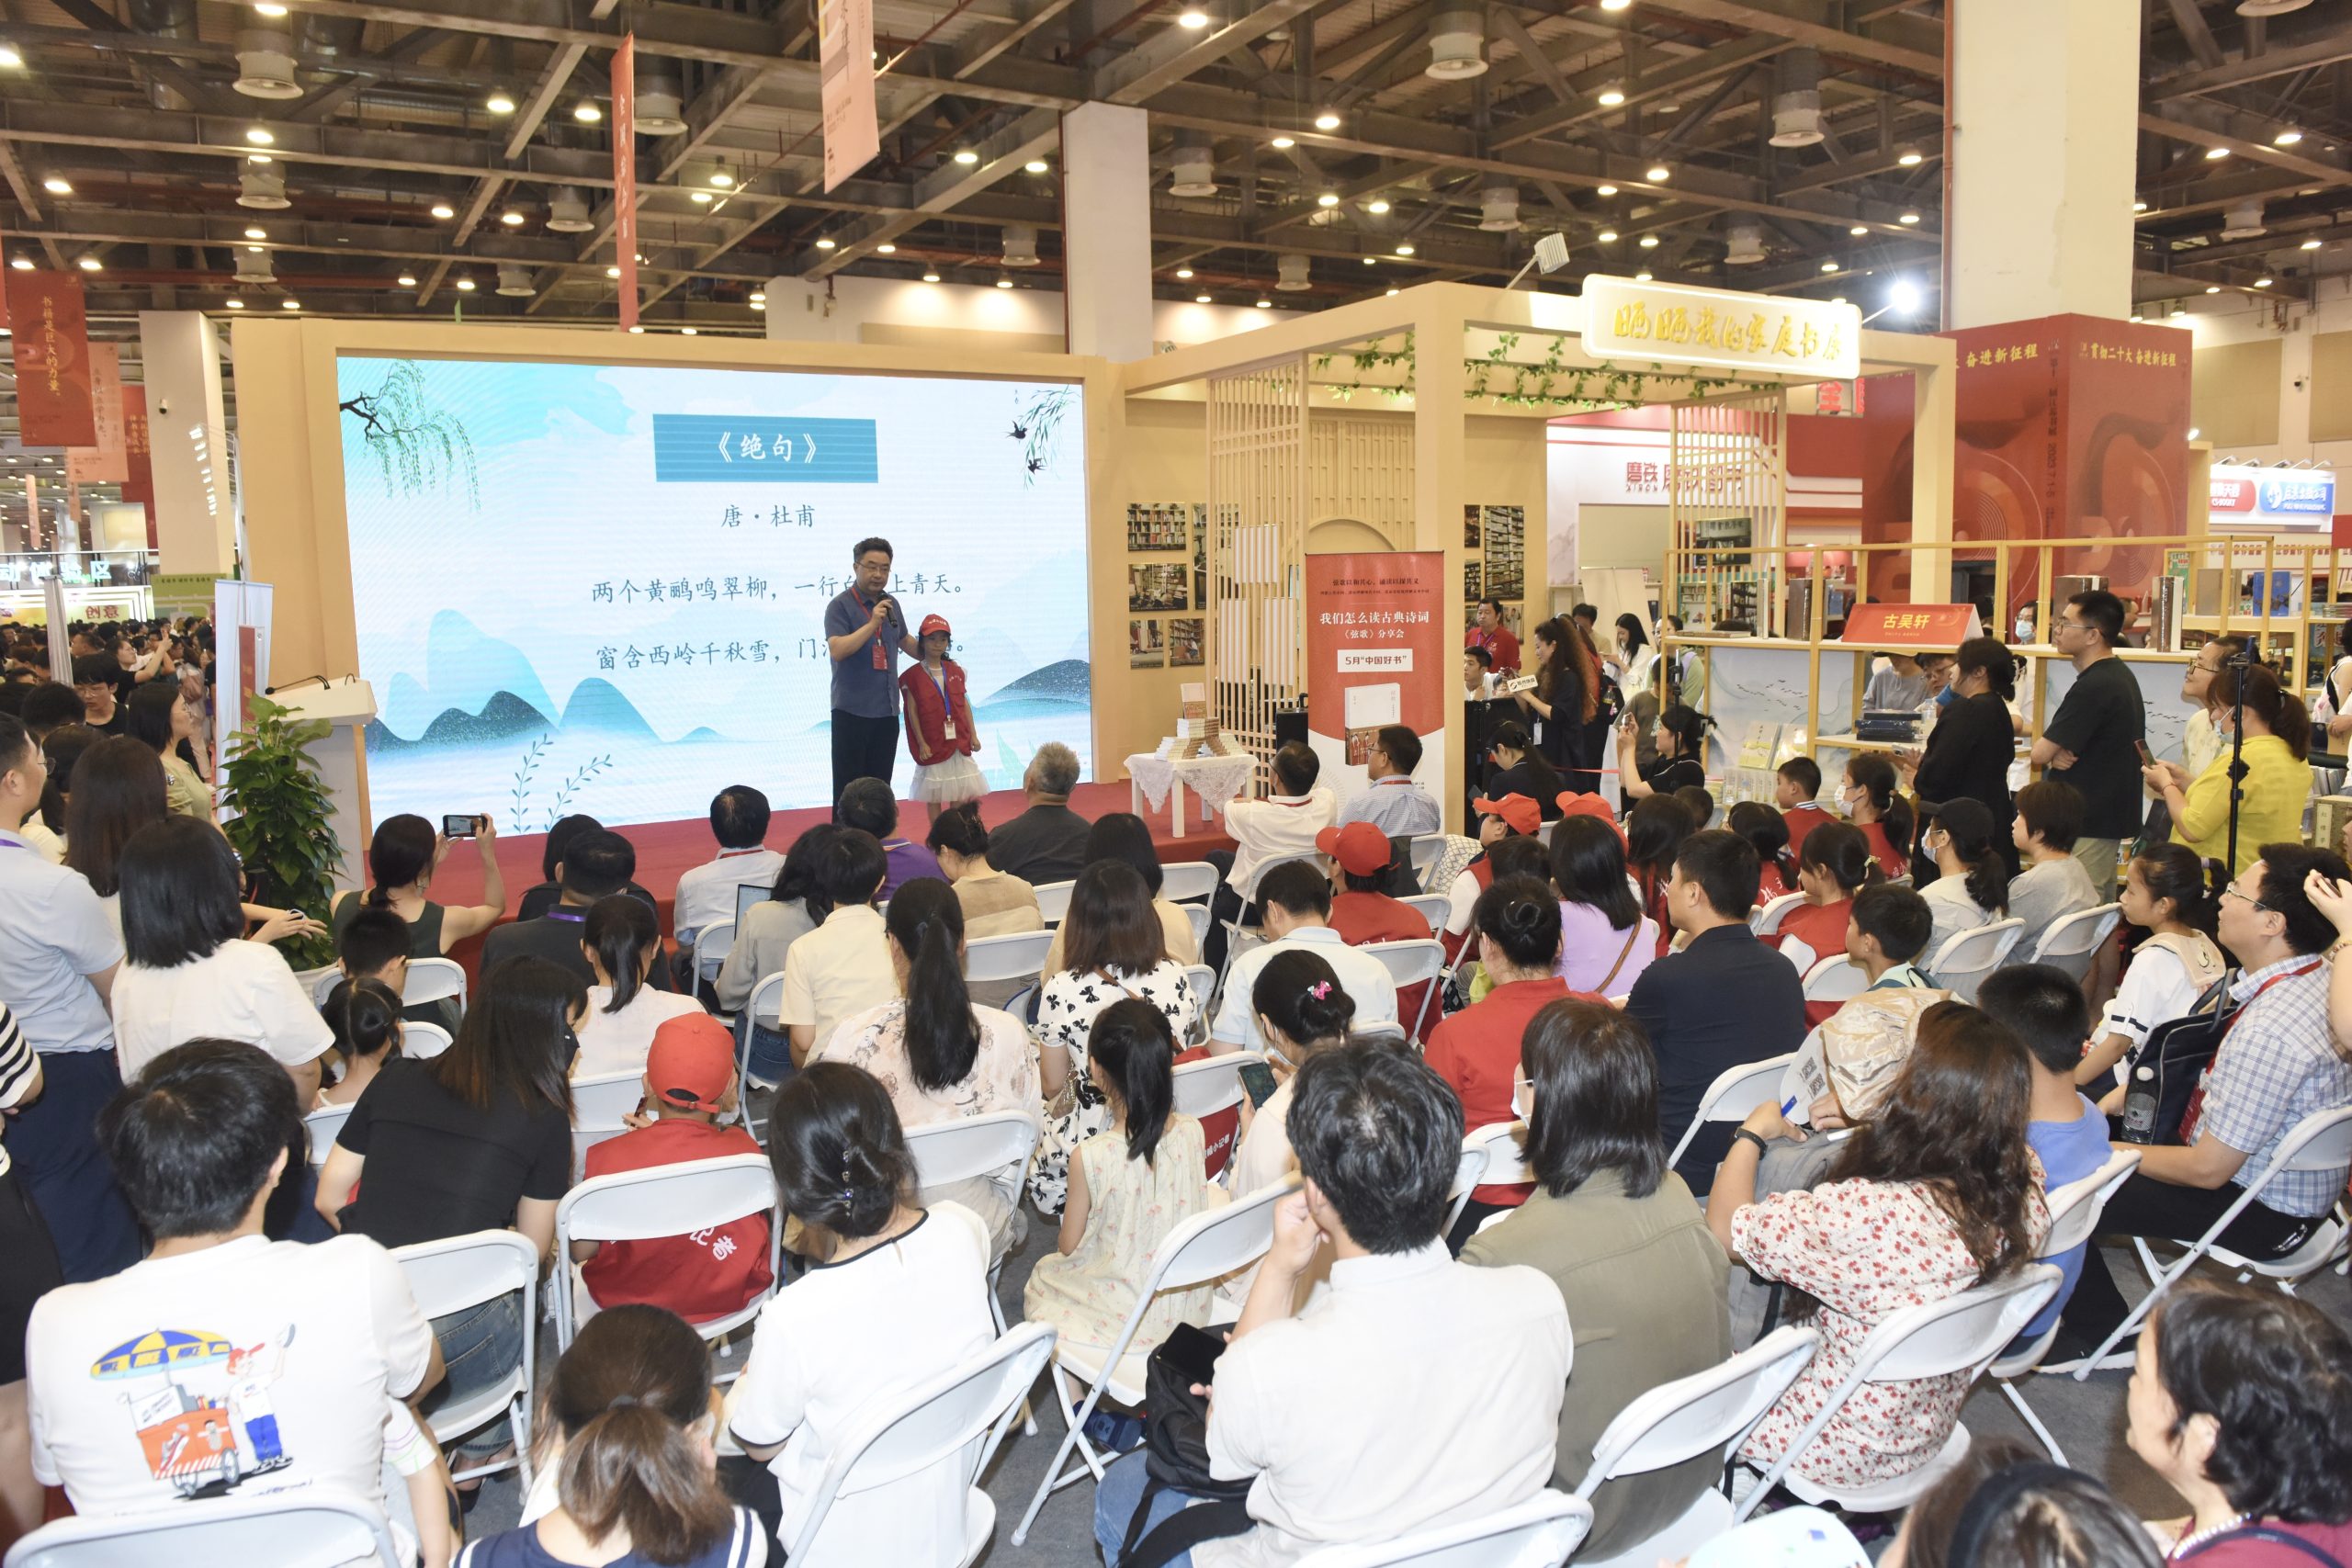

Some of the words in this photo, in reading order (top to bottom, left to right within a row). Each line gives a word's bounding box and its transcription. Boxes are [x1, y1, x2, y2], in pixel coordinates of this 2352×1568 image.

[1966, 343, 2039, 368] 奋进新征程
[2090, 342, 2132, 364] 贯彻二十大
[2136, 351, 2177, 367] 奋进新征程
[718, 431, 817, 463] 《绝句》
[720, 504, 815, 527] 唐·杜甫
[1319, 611, 1430, 625] 我们怎么读古典诗词
[1883, 614, 1931, 629] 古吴轩
